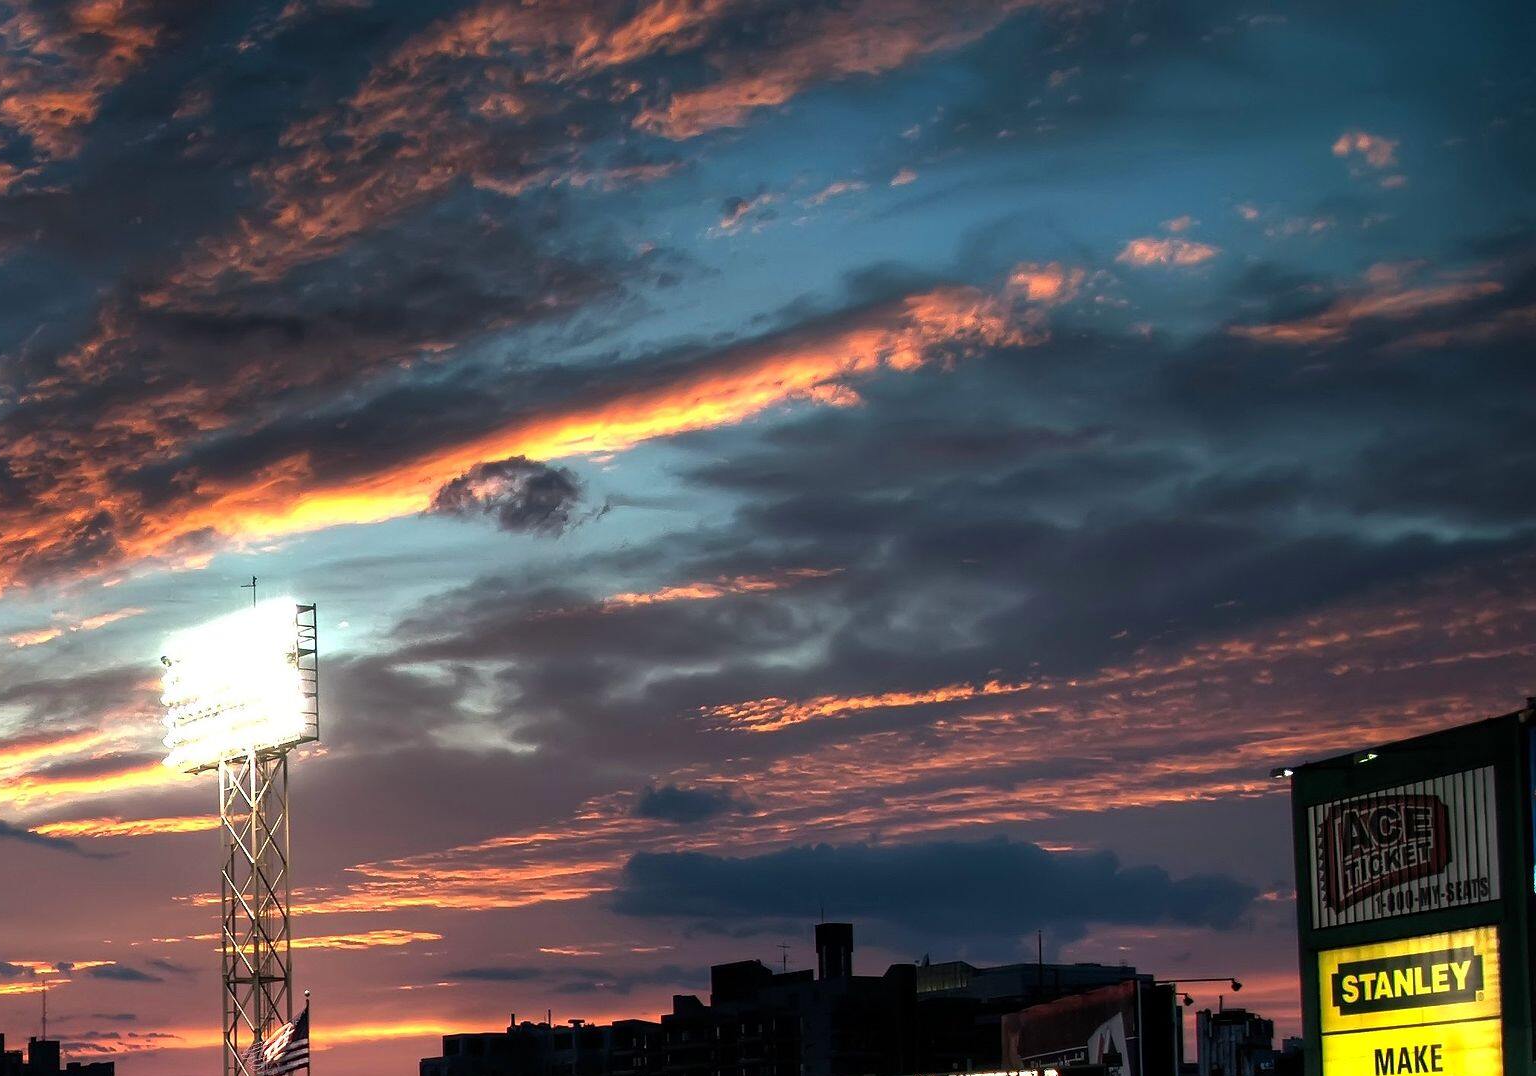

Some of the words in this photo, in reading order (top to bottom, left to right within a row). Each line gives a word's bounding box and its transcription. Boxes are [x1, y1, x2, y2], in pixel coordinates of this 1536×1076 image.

[1343, 804, 1433, 858] ACE
[1345, 844, 1433, 893] TICKET
[1341, 960, 1471, 1003] STANLEY
[1374, 1044, 1443, 1076] MAKE
